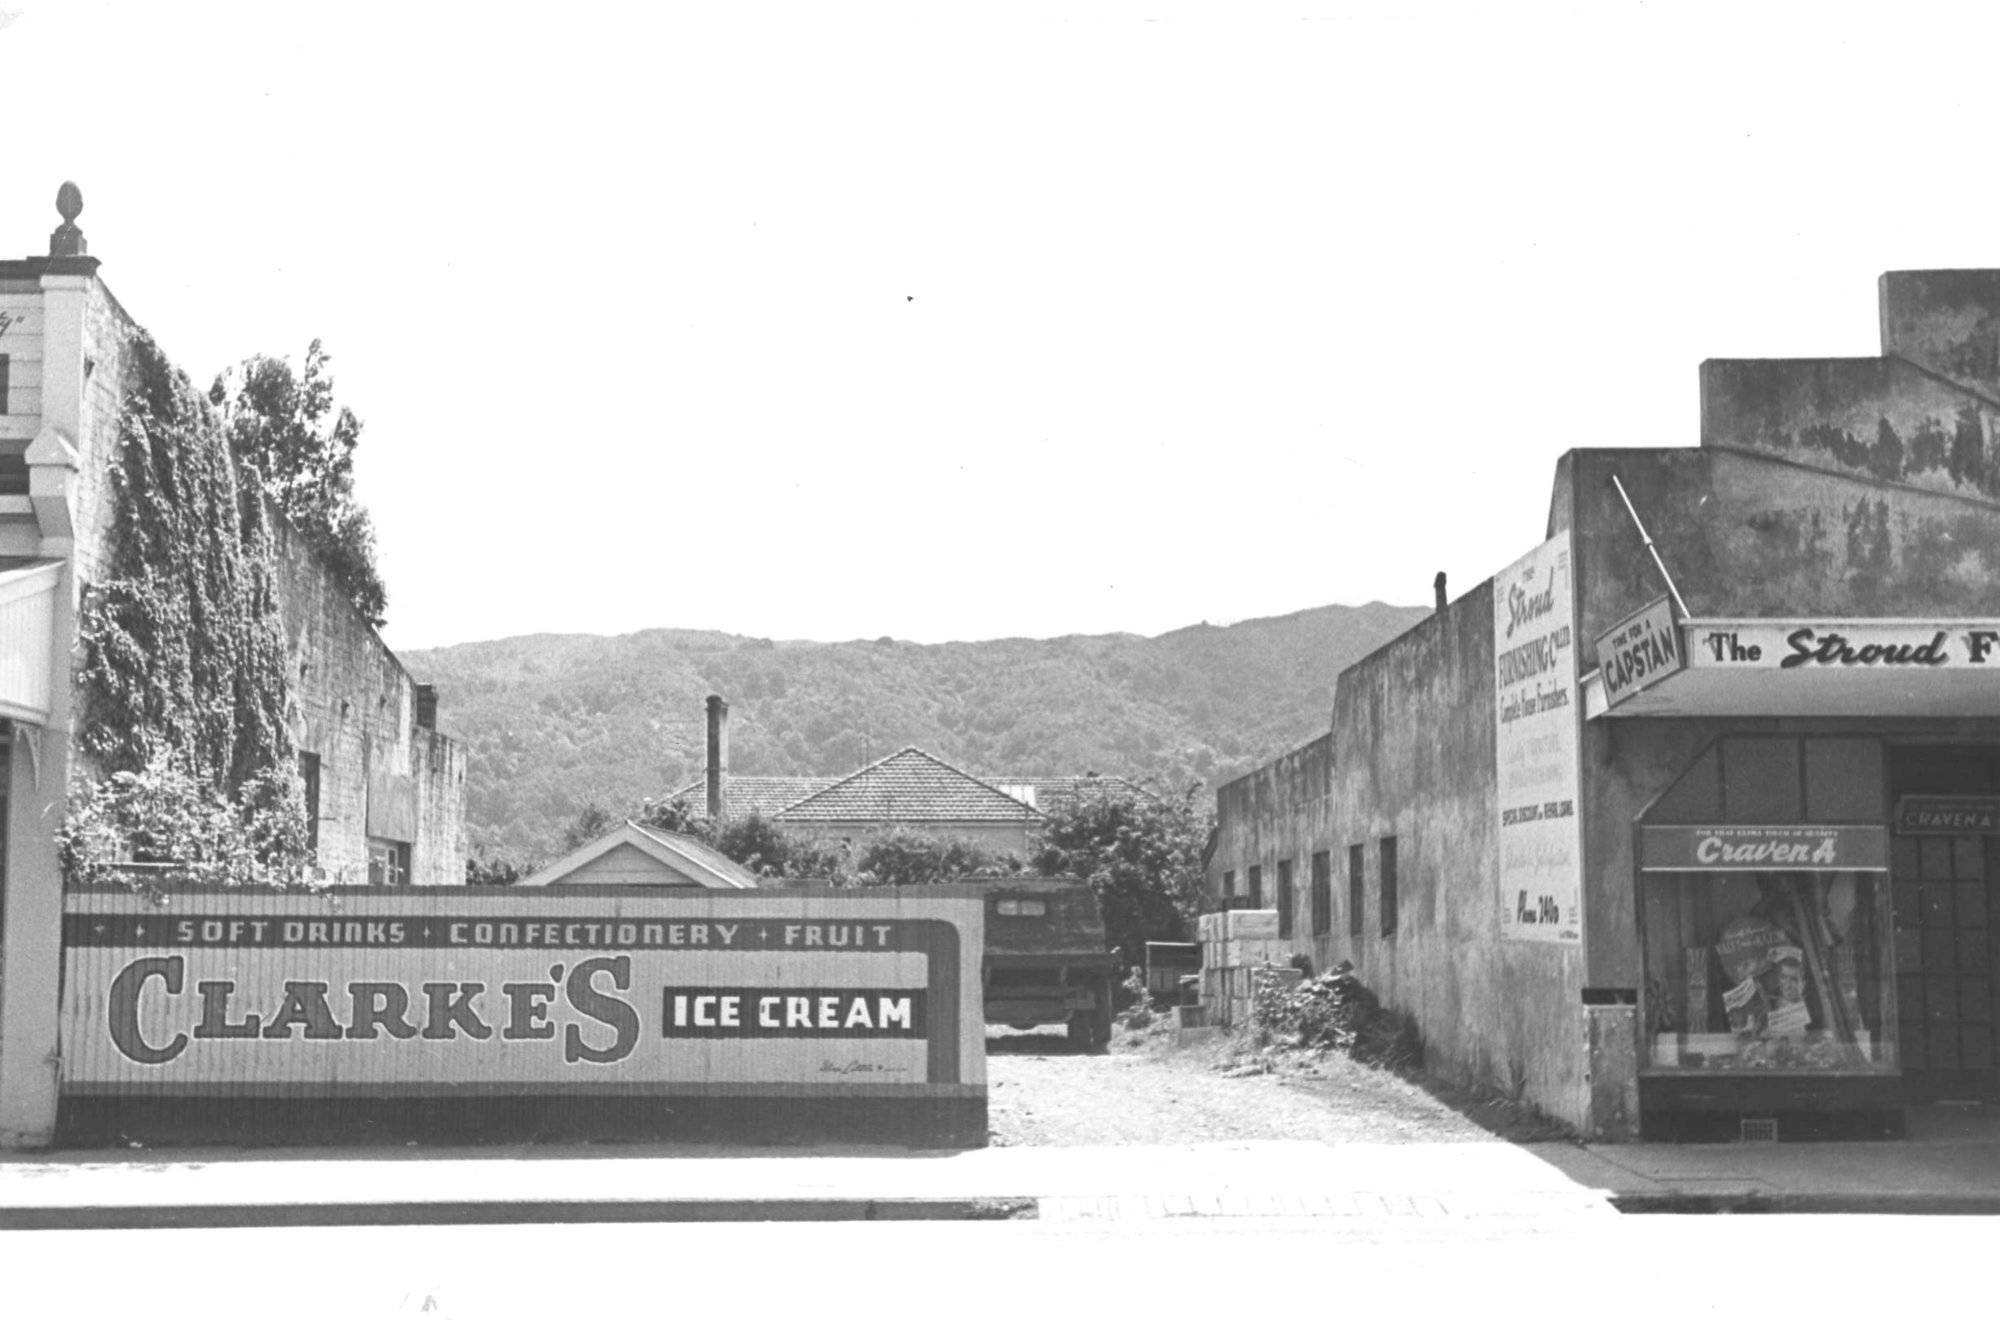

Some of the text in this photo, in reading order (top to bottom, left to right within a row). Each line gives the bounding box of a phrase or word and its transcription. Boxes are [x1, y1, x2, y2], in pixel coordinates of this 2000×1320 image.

[1507, 565, 1555, 639] Stroud
[1628, 623, 1643, 640] FOR
[1645, 618, 1652, 630] A
[1499, 634, 1549, 690] FURNISHING
[1605, 625, 1677, 693] CAPSTAN
[1703, 632, 1762, 662] The
[1780, 628, 1951, 669] Stroud
[1905, 811, 1992, 827] CRAVEN A
[1697, 836, 1810, 864] Craven
[178, 920, 893, 946] SOFT DRINKS CONFECTIONERY FRUIT
[107, 954, 641, 1066] CLARKE'S
[673, 995, 913, 1030] ICE CREAM
